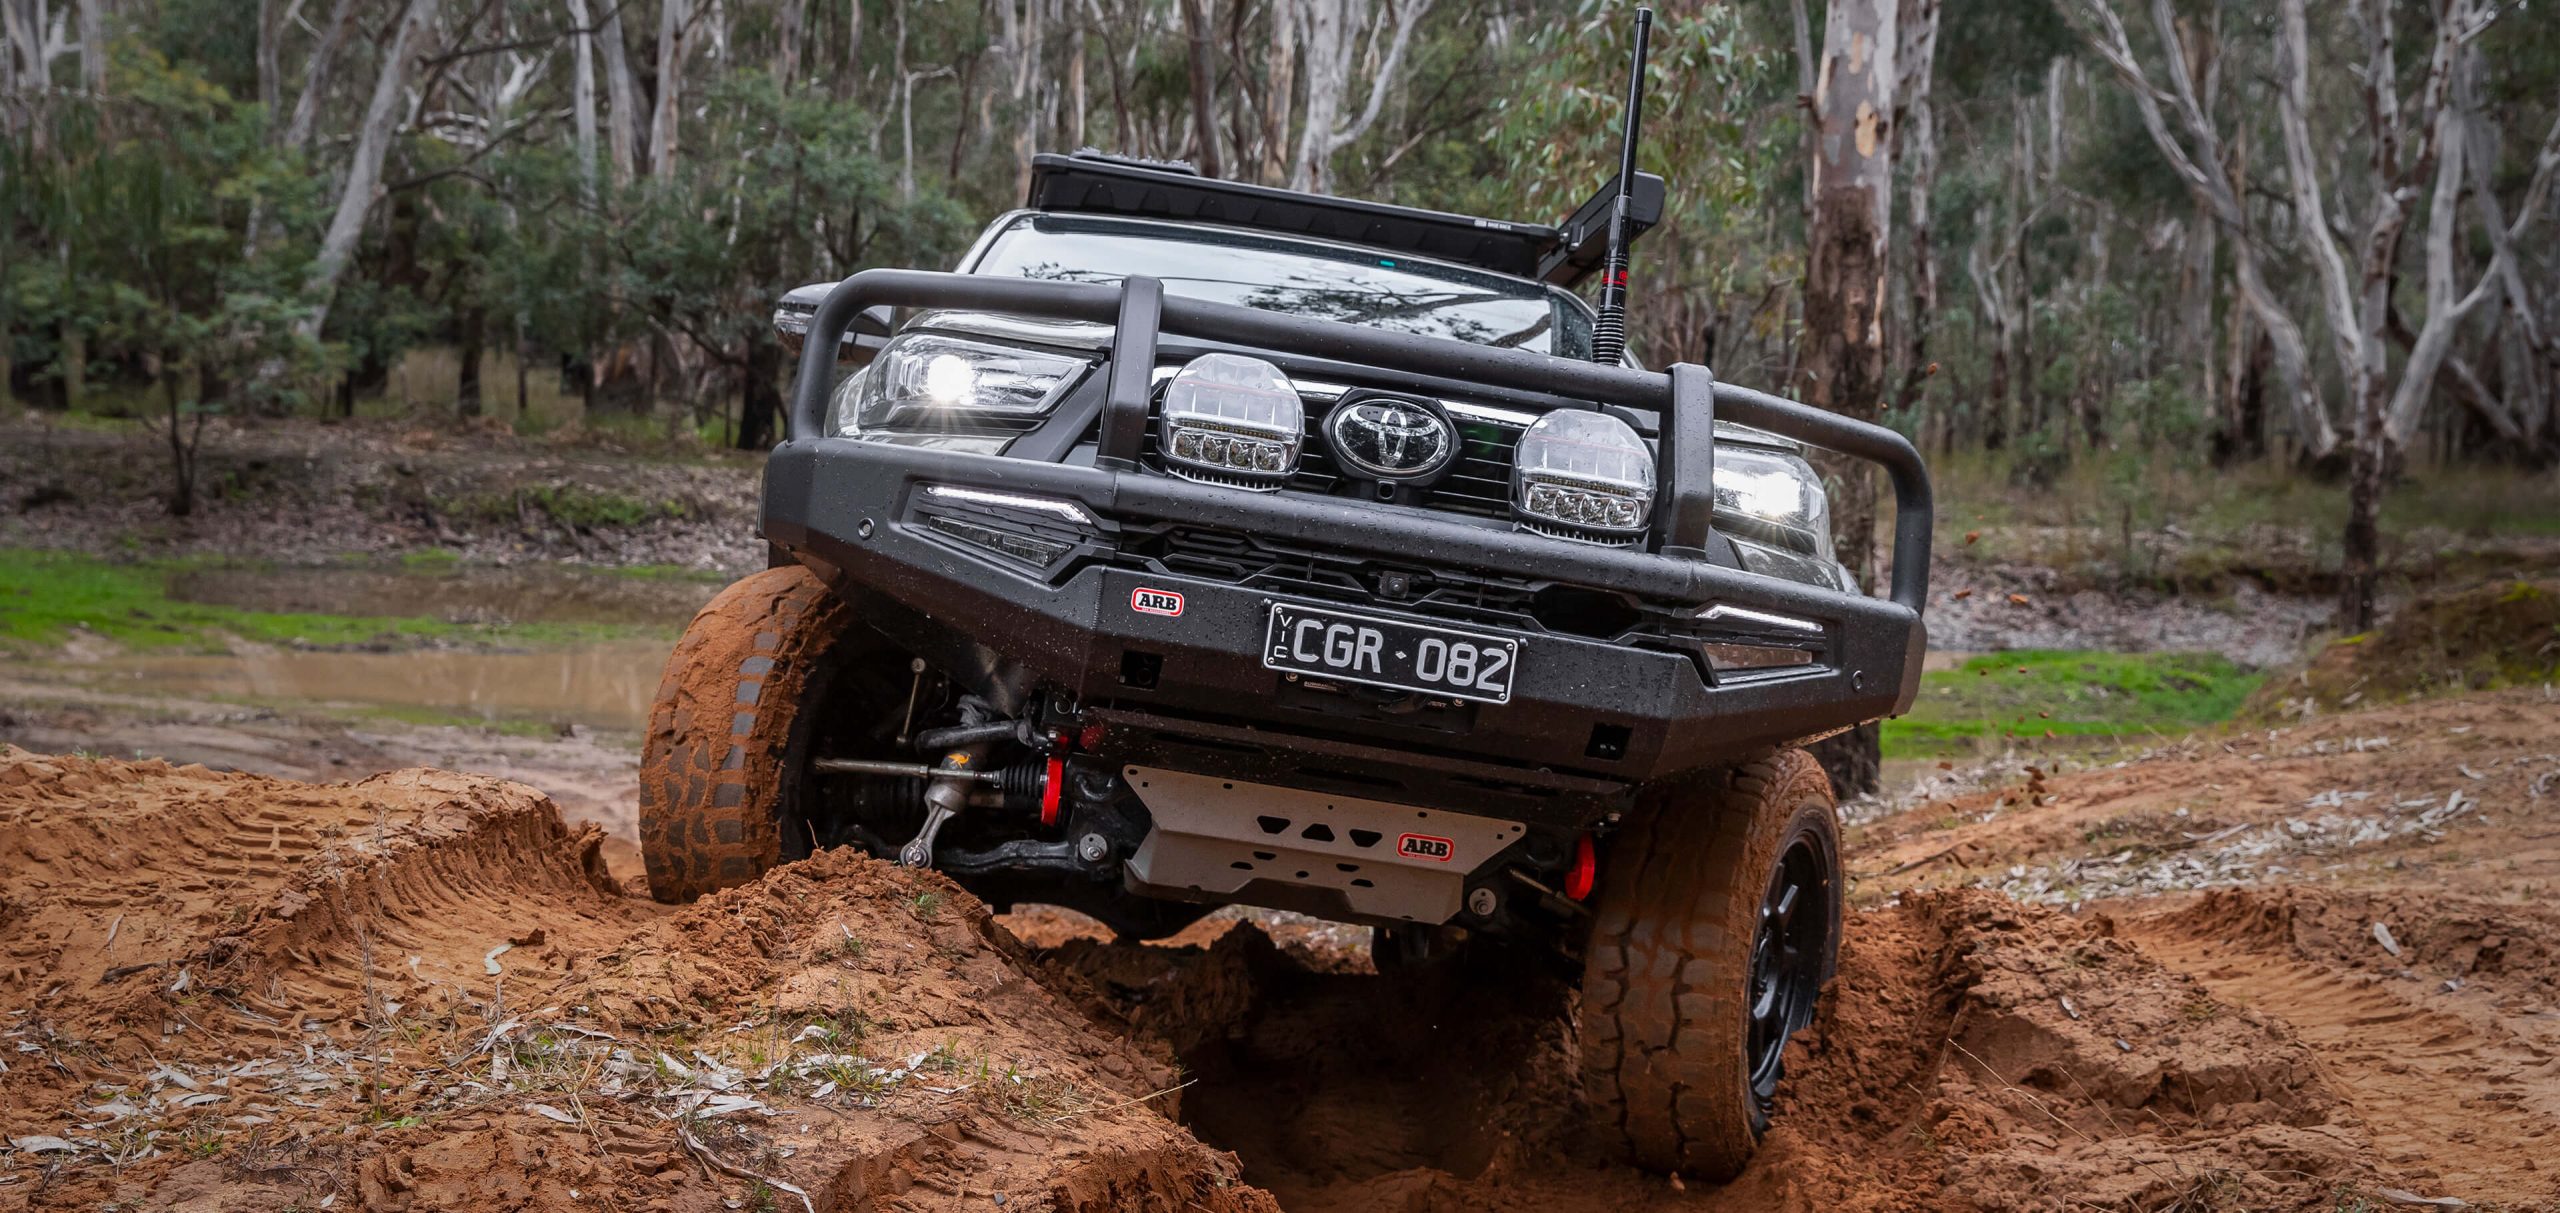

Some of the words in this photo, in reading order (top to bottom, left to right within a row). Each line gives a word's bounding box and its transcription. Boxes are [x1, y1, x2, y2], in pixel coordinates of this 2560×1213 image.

[1138, 593, 1177, 611] ARB
[1273, 614, 1293, 659] VIC
[1293, 618, 1384, 674] CGR
[1416, 638, 1509, 692] 082
[1403, 838, 1448, 857] ARB
